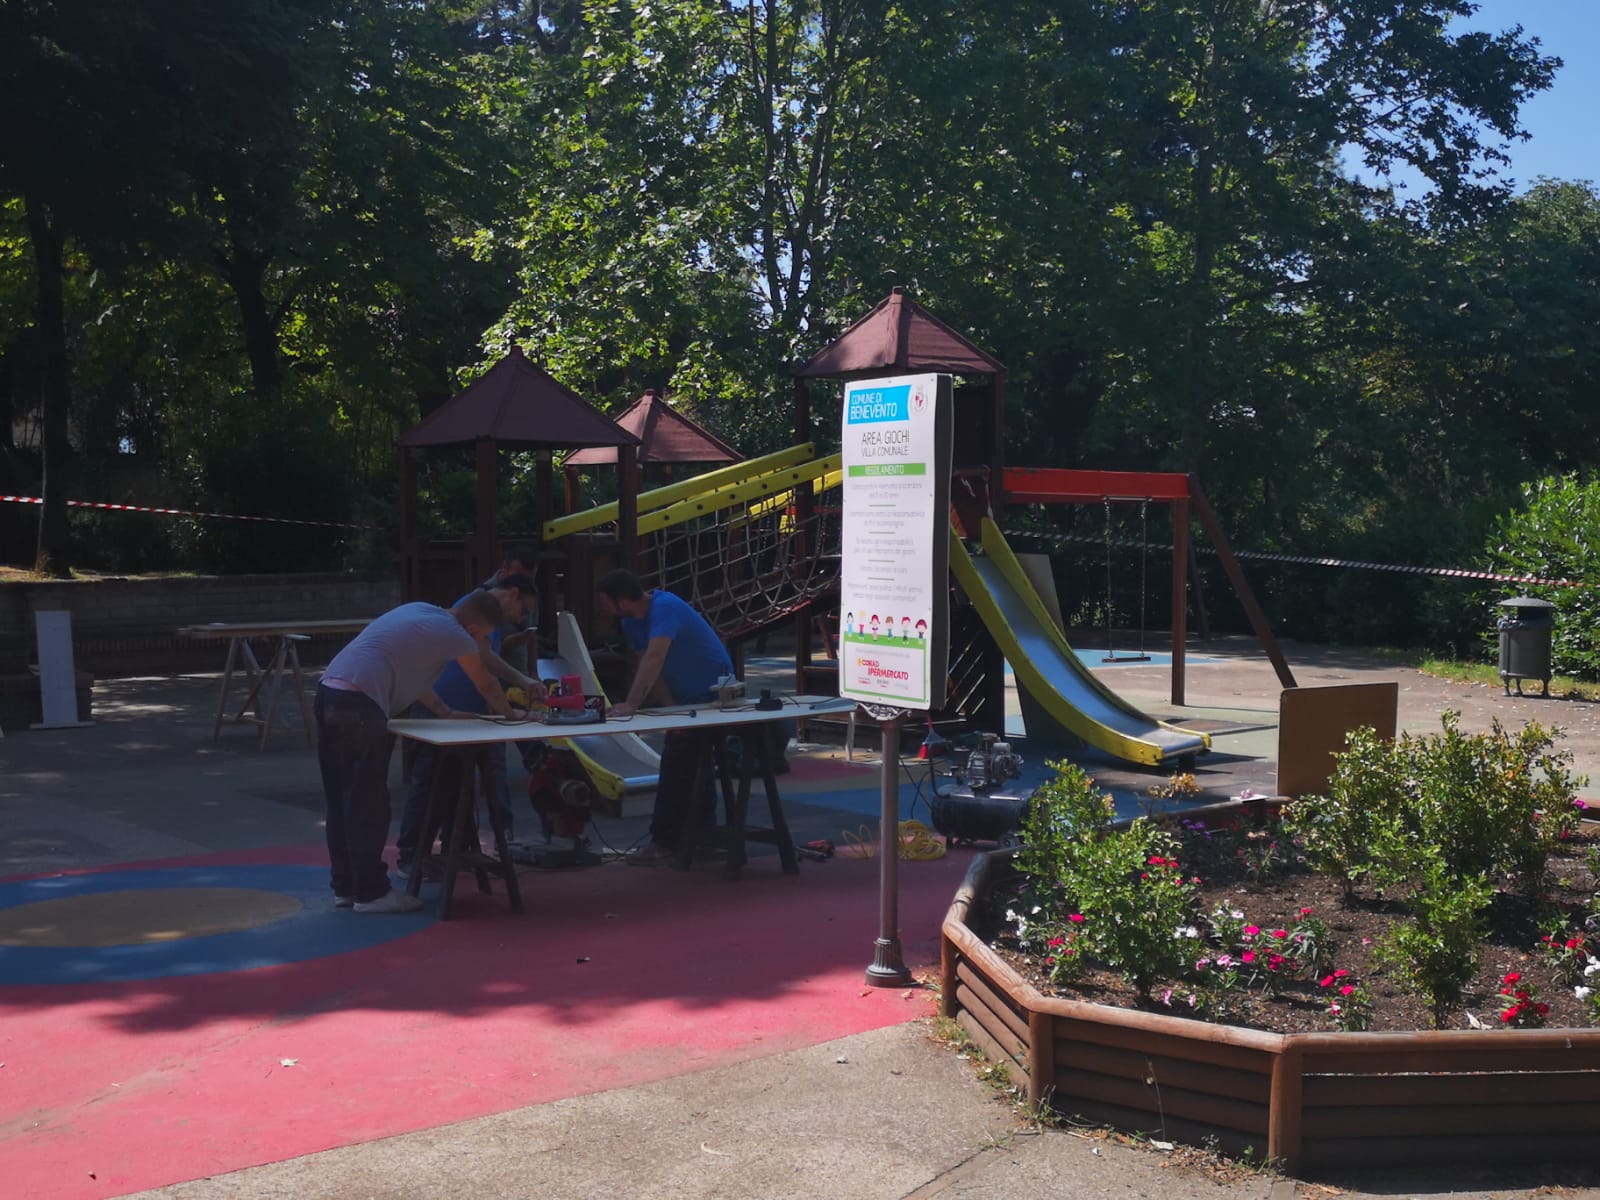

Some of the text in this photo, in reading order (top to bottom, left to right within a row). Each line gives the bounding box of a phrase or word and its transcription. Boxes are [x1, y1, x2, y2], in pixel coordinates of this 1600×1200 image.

[851, 393, 875, 405] COMUNE
[850, 402, 898, 420] BENEVENTO
[861, 429, 910, 445] AREA GIOCHI
[861, 446, 909, 457] VILLA COMUNALE
